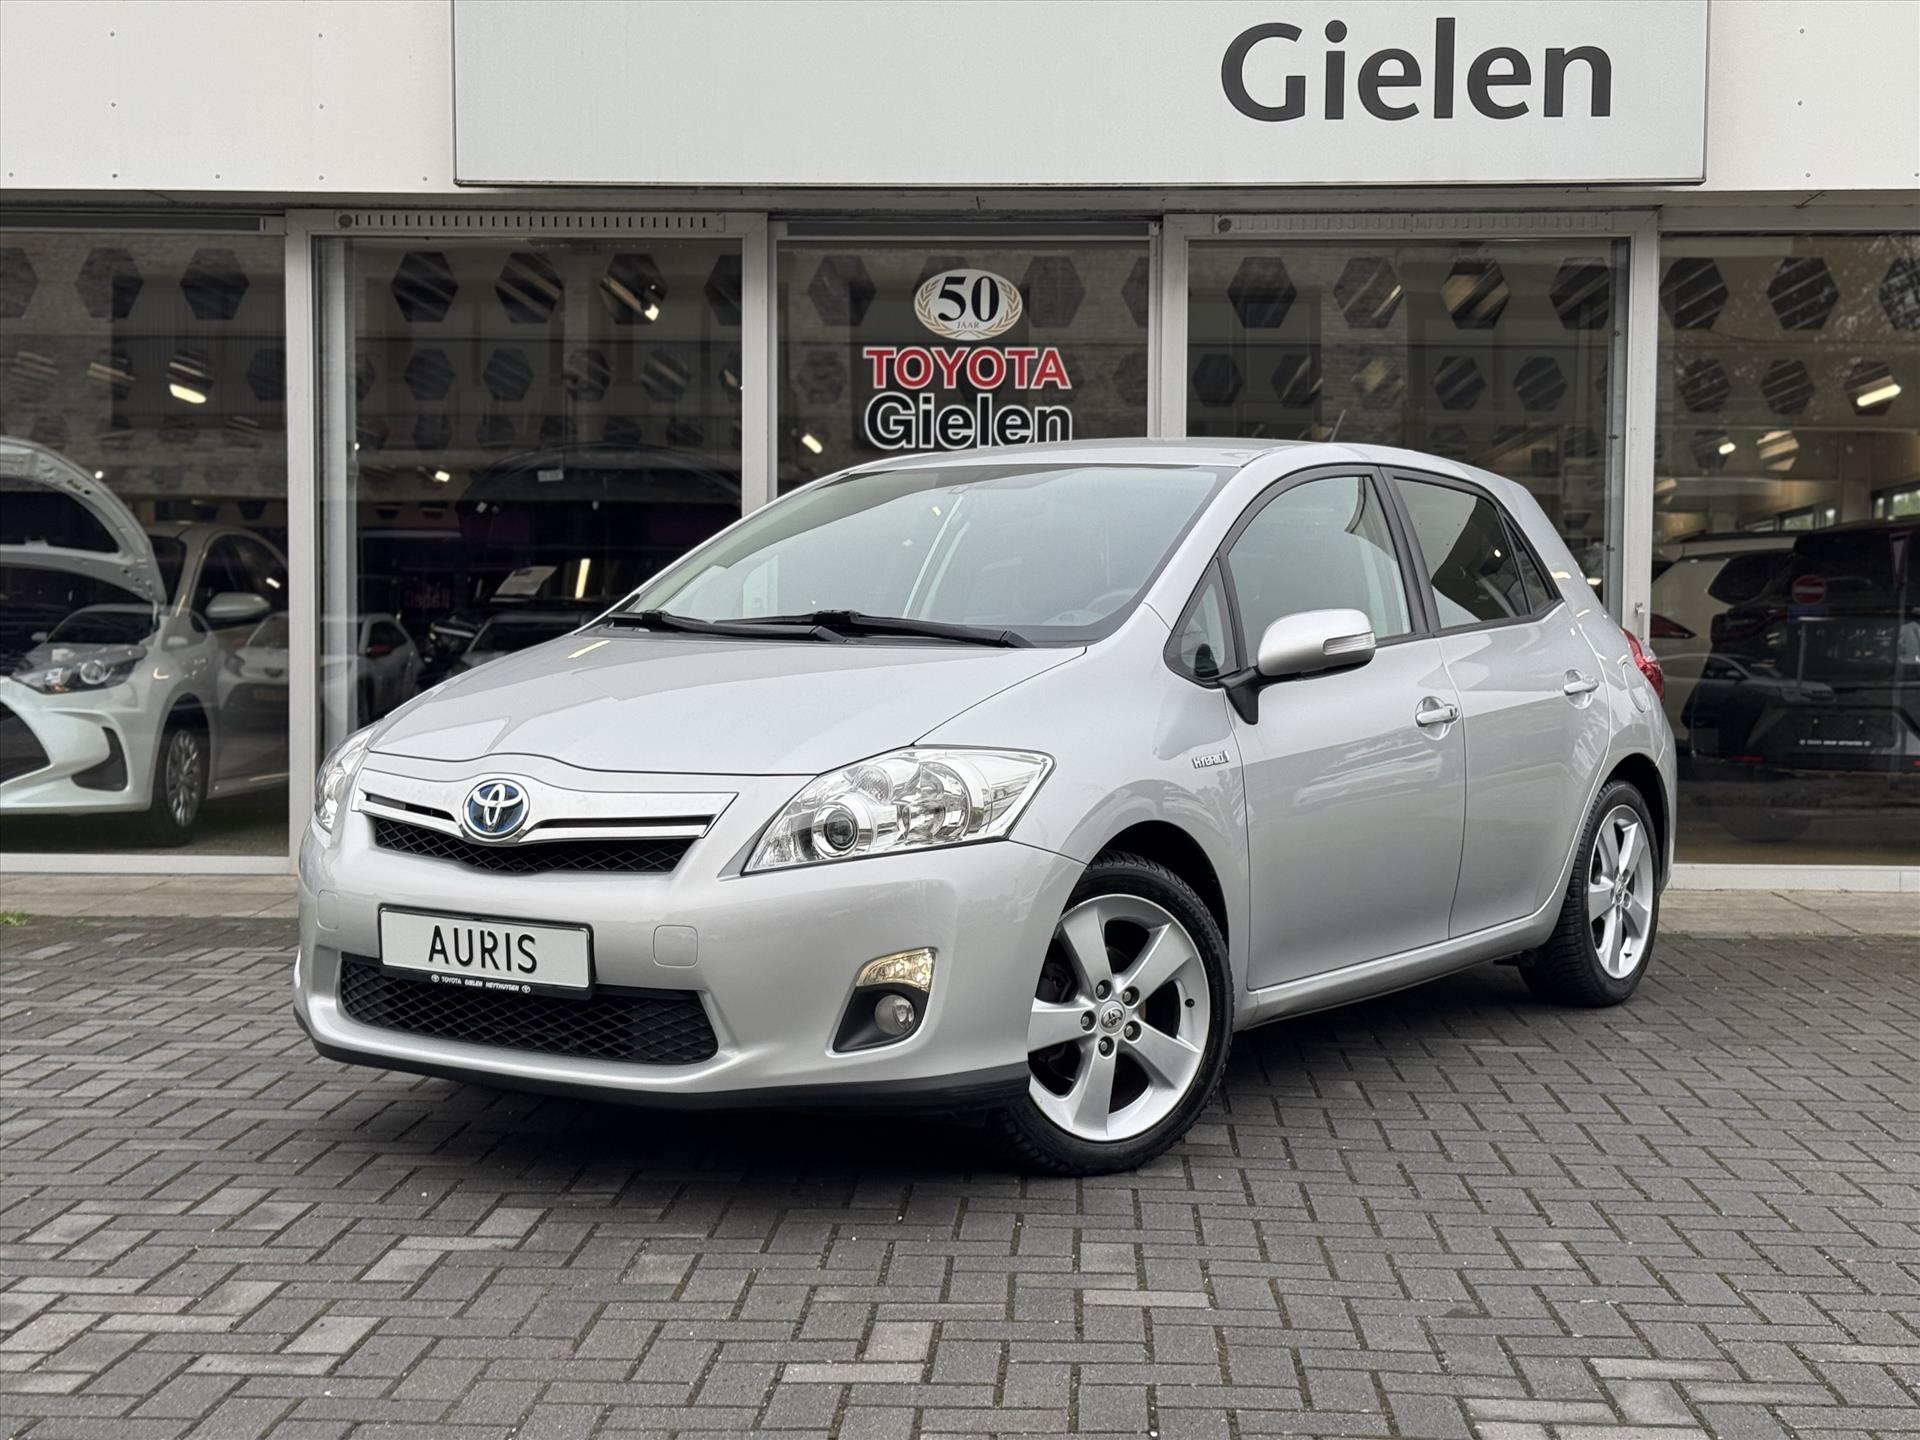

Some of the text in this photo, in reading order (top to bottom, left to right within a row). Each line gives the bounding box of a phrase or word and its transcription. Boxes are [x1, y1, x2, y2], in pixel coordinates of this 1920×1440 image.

[1221, 17, 1612, 122] Gielen
[938, 276, 999, 322] 50
[956, 321, 980, 330] JAAR
[863, 346, 1072, 390] TOYOTA
[864, 391, 1073, 450] Gielen
[428, 925, 538, 974] AURIS
[441, 976, 462, 985] TOYOTA
[464, 979, 483, 987] GIELEN
